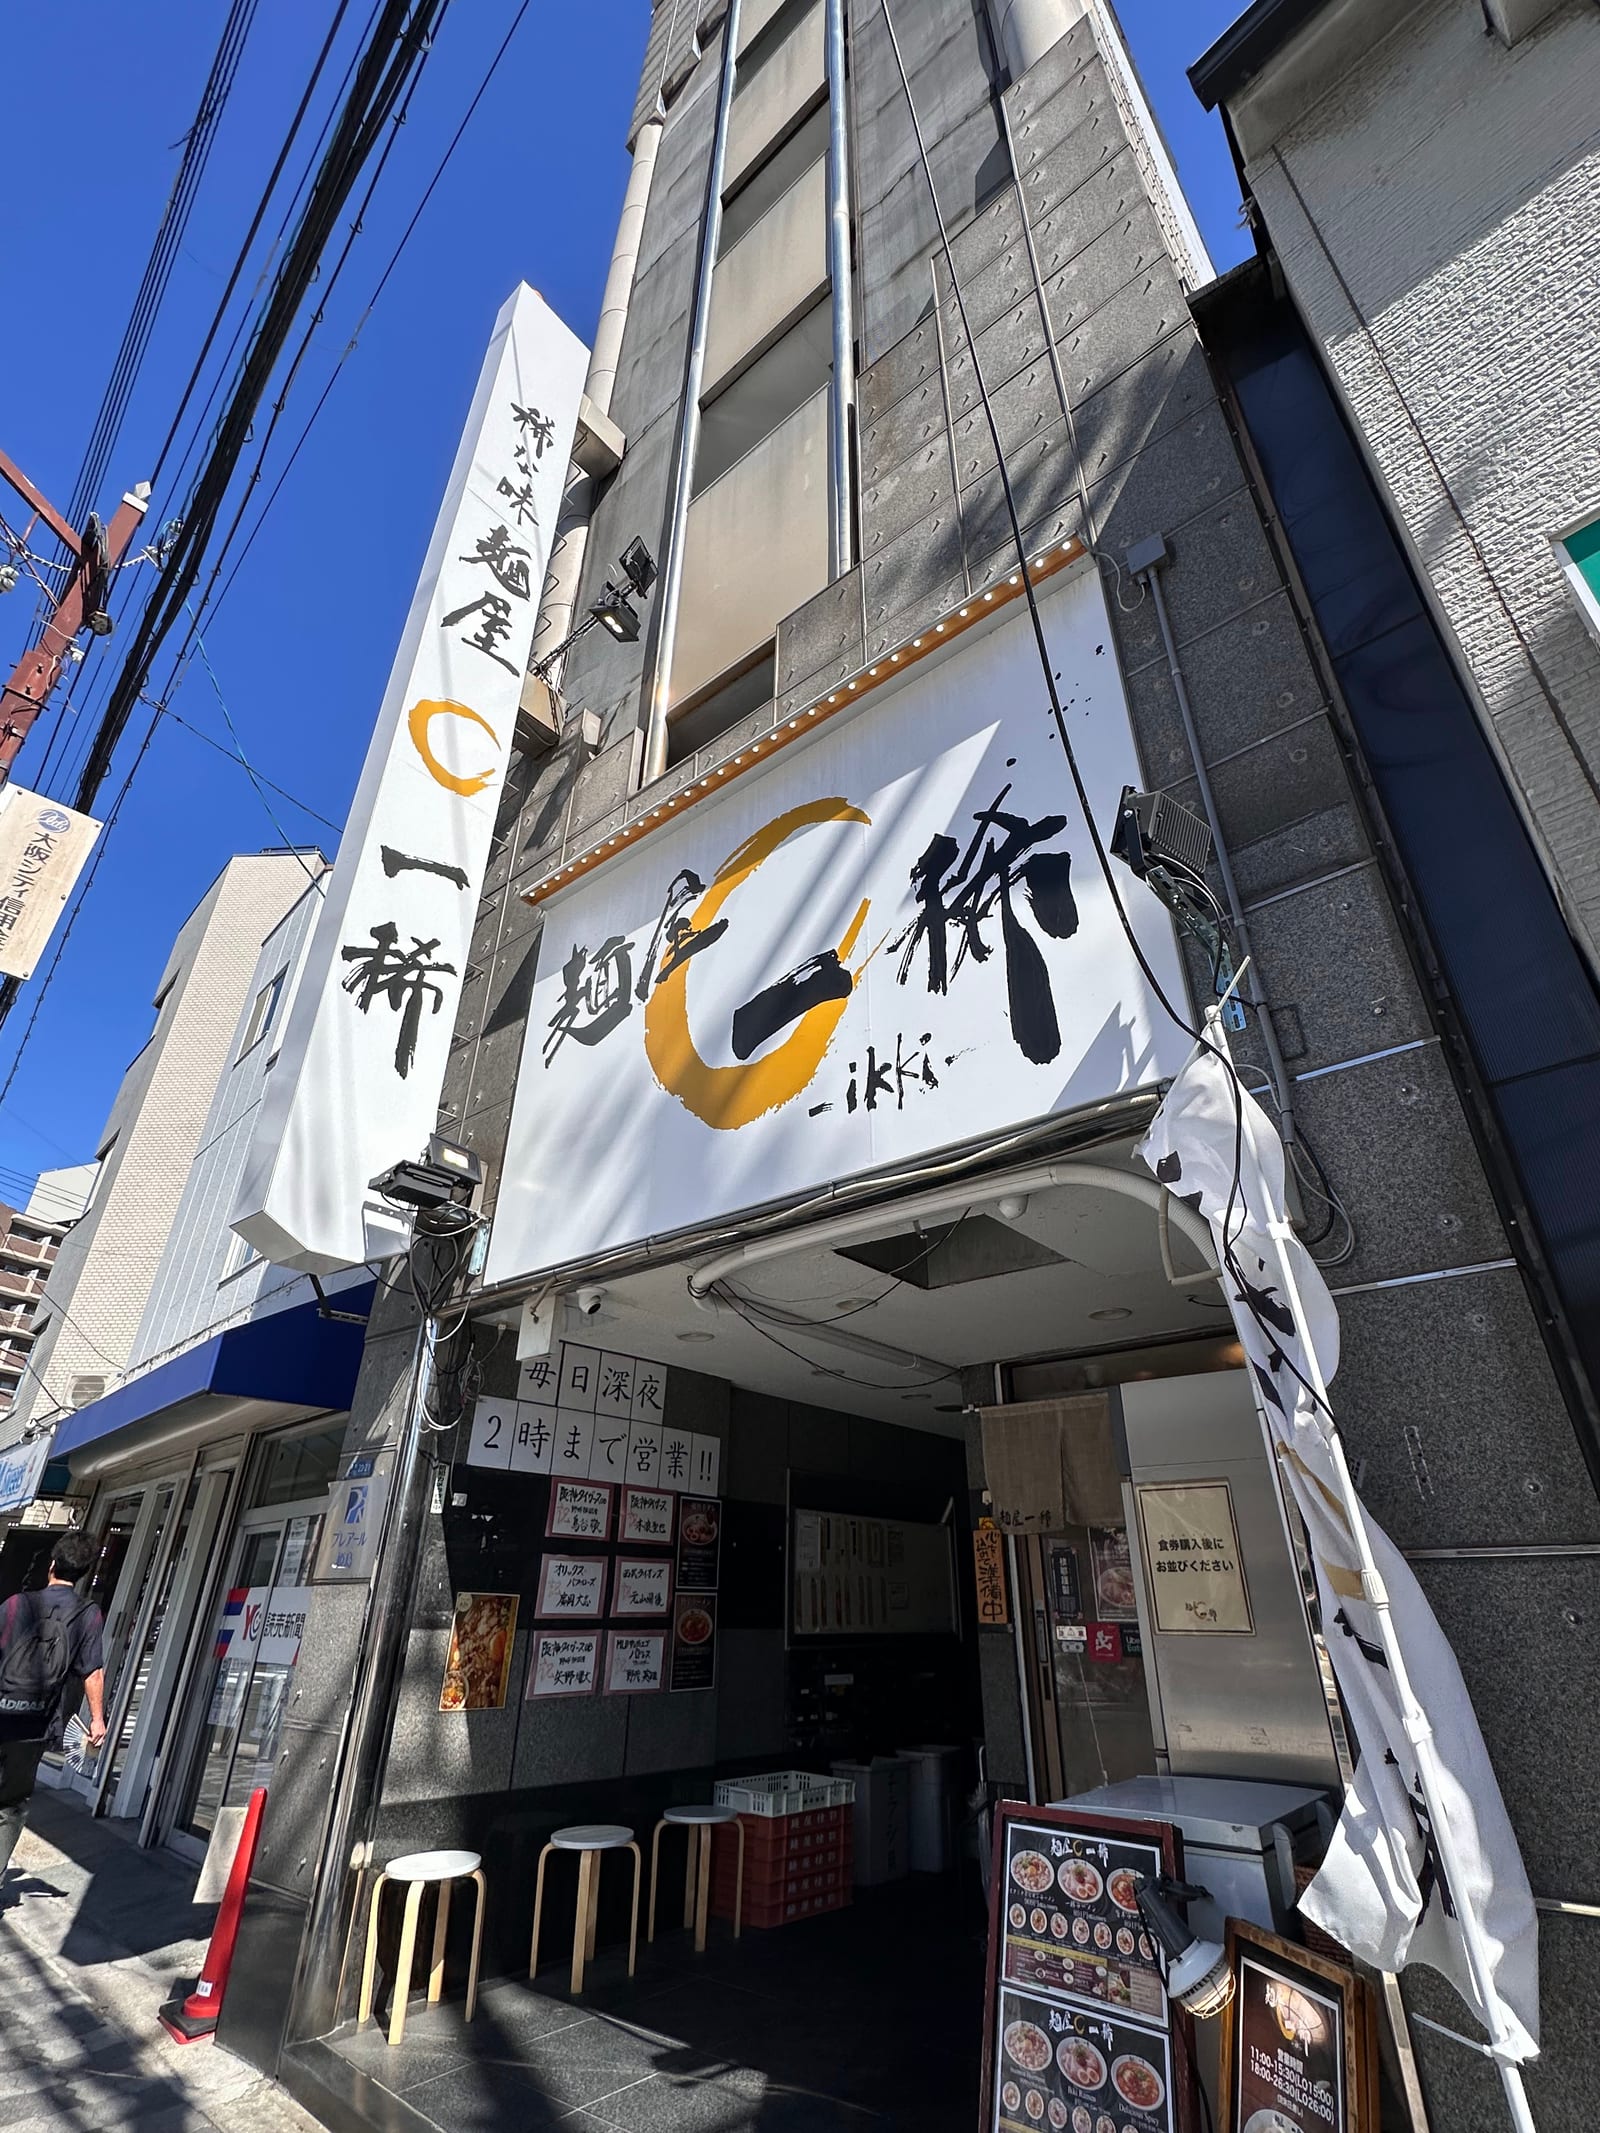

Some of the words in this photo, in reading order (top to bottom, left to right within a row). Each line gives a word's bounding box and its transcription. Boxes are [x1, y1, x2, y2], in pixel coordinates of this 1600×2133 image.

[525, 1355, 663, 1410] 毎日深夜
[1158, 1537, 1225, 1552] 食券購入後に
[1155, 1559, 1235, 1573] お並びください
[263, 1611, 307, 1640] 読売新聞
